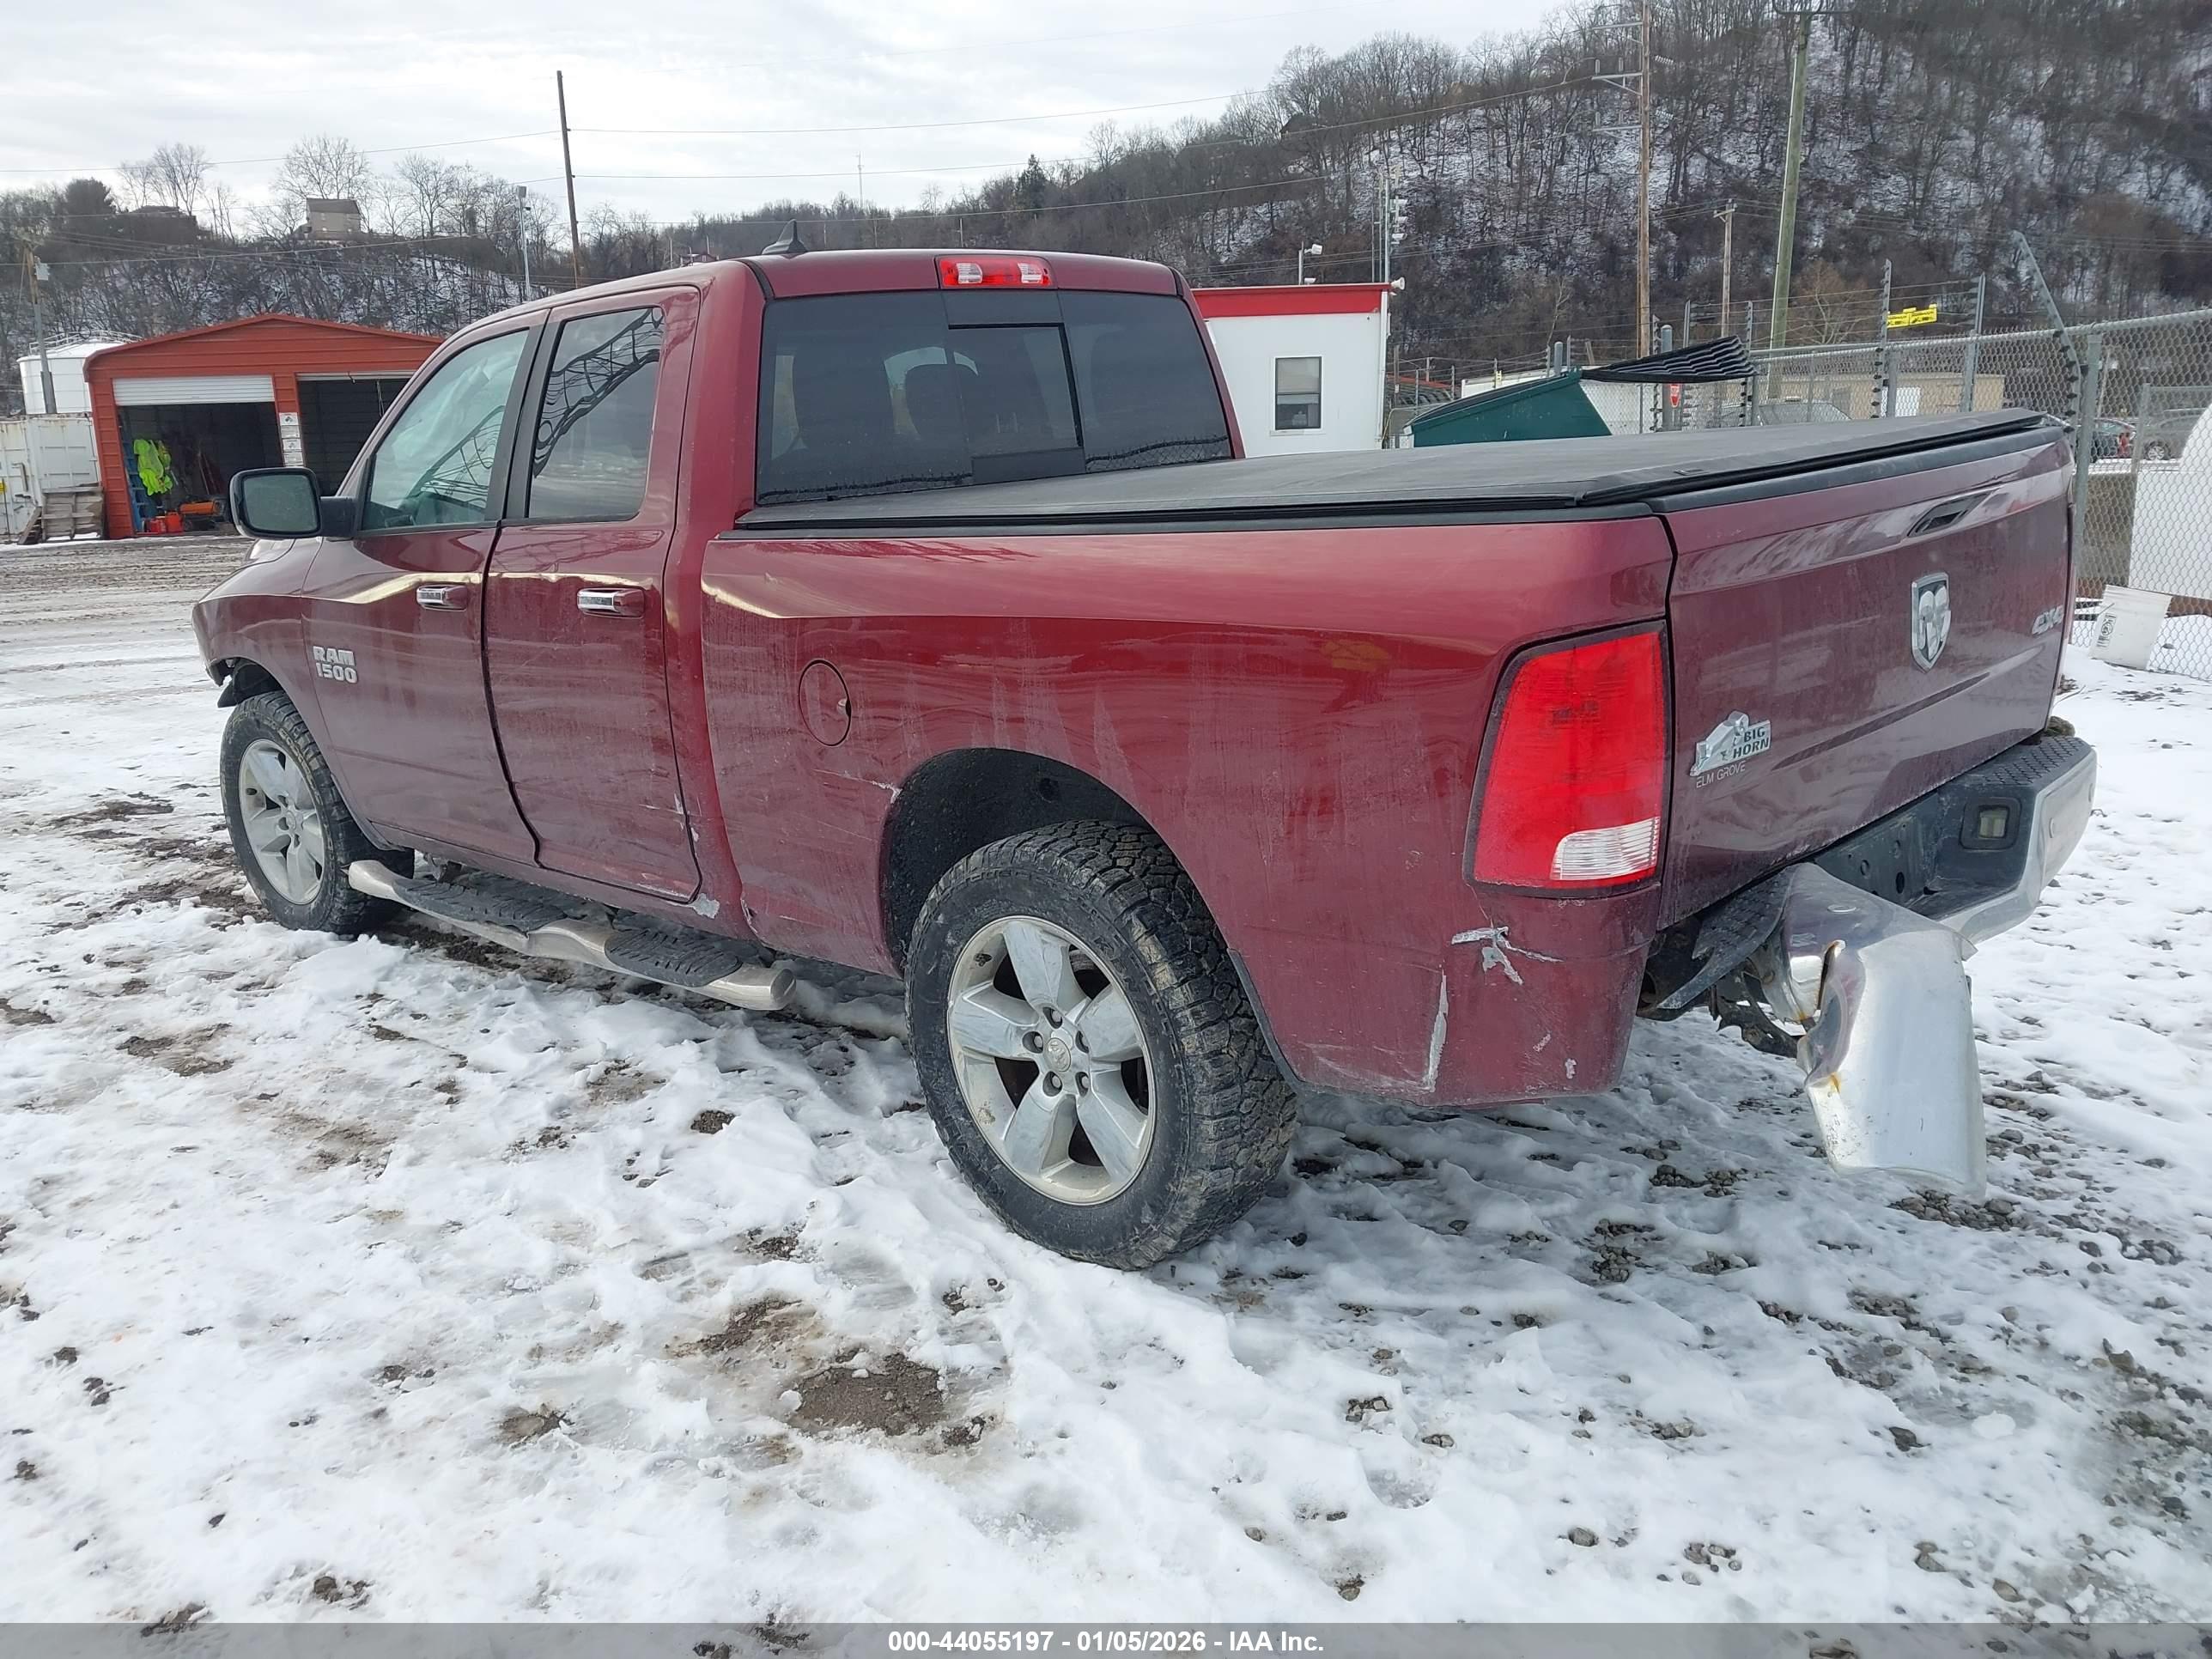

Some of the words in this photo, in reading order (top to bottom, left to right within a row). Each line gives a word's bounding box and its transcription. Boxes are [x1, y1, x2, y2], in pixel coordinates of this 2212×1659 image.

[313, 646, 355, 665] RAM
[316, 663, 358, 684] 1500
[1744, 727, 1765, 742] BIG
[1733, 738, 1769, 758] HORN
[1696, 774, 1714, 788] ELM
[1717, 761, 1746, 780] GROVE
